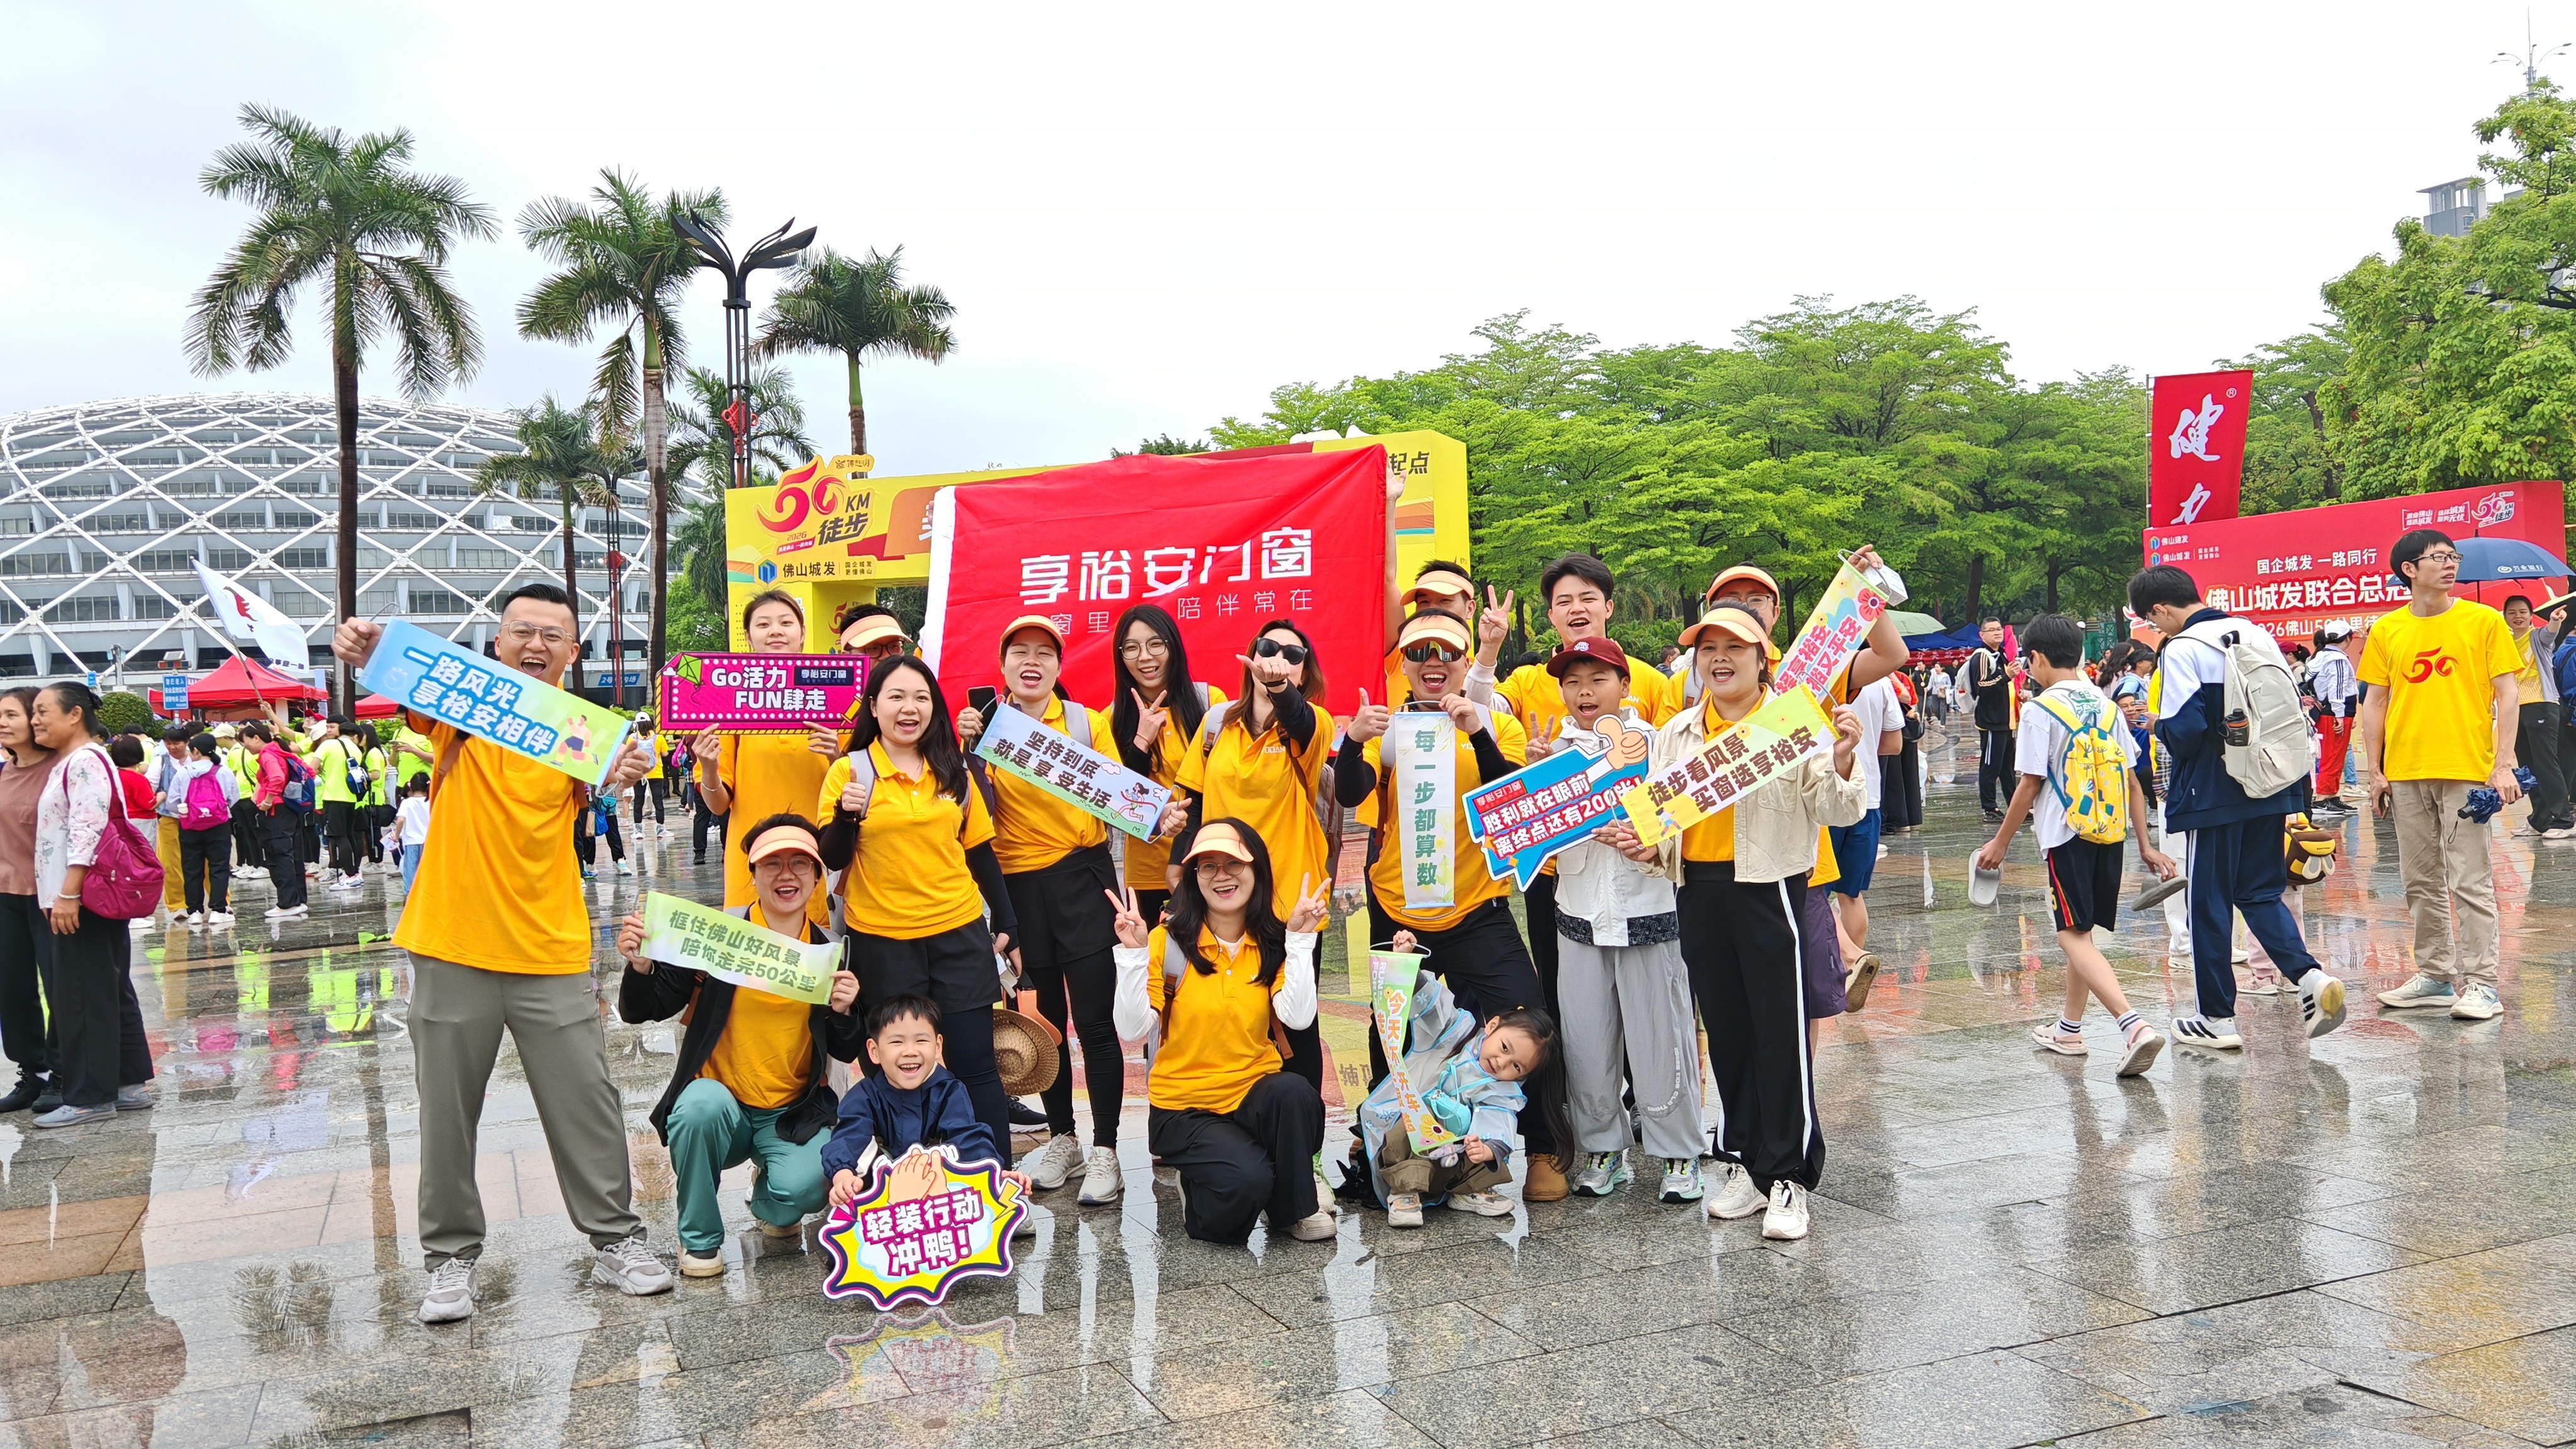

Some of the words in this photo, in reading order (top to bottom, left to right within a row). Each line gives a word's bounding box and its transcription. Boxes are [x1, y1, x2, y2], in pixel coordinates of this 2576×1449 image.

[845, 492, 870, 513] KM
[787, 531, 807, 541] 2026
[818, 513, 869, 546] 徒步
[783, 562, 835, 578] 佛山城发
[1019, 527, 1312, 606] 享裕安门窗
[2163, 552, 2190, 562] 佛山城发
[2257, 555, 2313, 575] 国企城发
[2318, 548, 2377, 567] 一路同行
[1177, 589, 1313, 621] 陪伴常在
[405, 648, 522, 710] 一路风光
[711, 666, 787, 689] Go活力
[1806, 616, 1863, 696] 裕又平安
[2401, 646, 2459, 684] 50
[411, 679, 556, 754] 享裕安相伴
[735, 689, 826, 711] FUN肆走
[993, 737, 1113, 810] 就是享受生活
[1024, 730, 1101, 780] 坚持到底
[1647, 733, 1750, 808] 徒步看风景
[1690, 725, 1818, 814] 买窗选享裕安
[1414, 730, 1437, 887] 每一步都算数
[1482, 771, 1591, 835] 胜利就在眼前
[669, 909, 802, 969] 框住佛山好风景
[680, 936, 818, 993] 陪你走完50公里
[863, 1189, 982, 1241] 轻装行动
[890, 1226, 970, 1274] 冲鸭!
